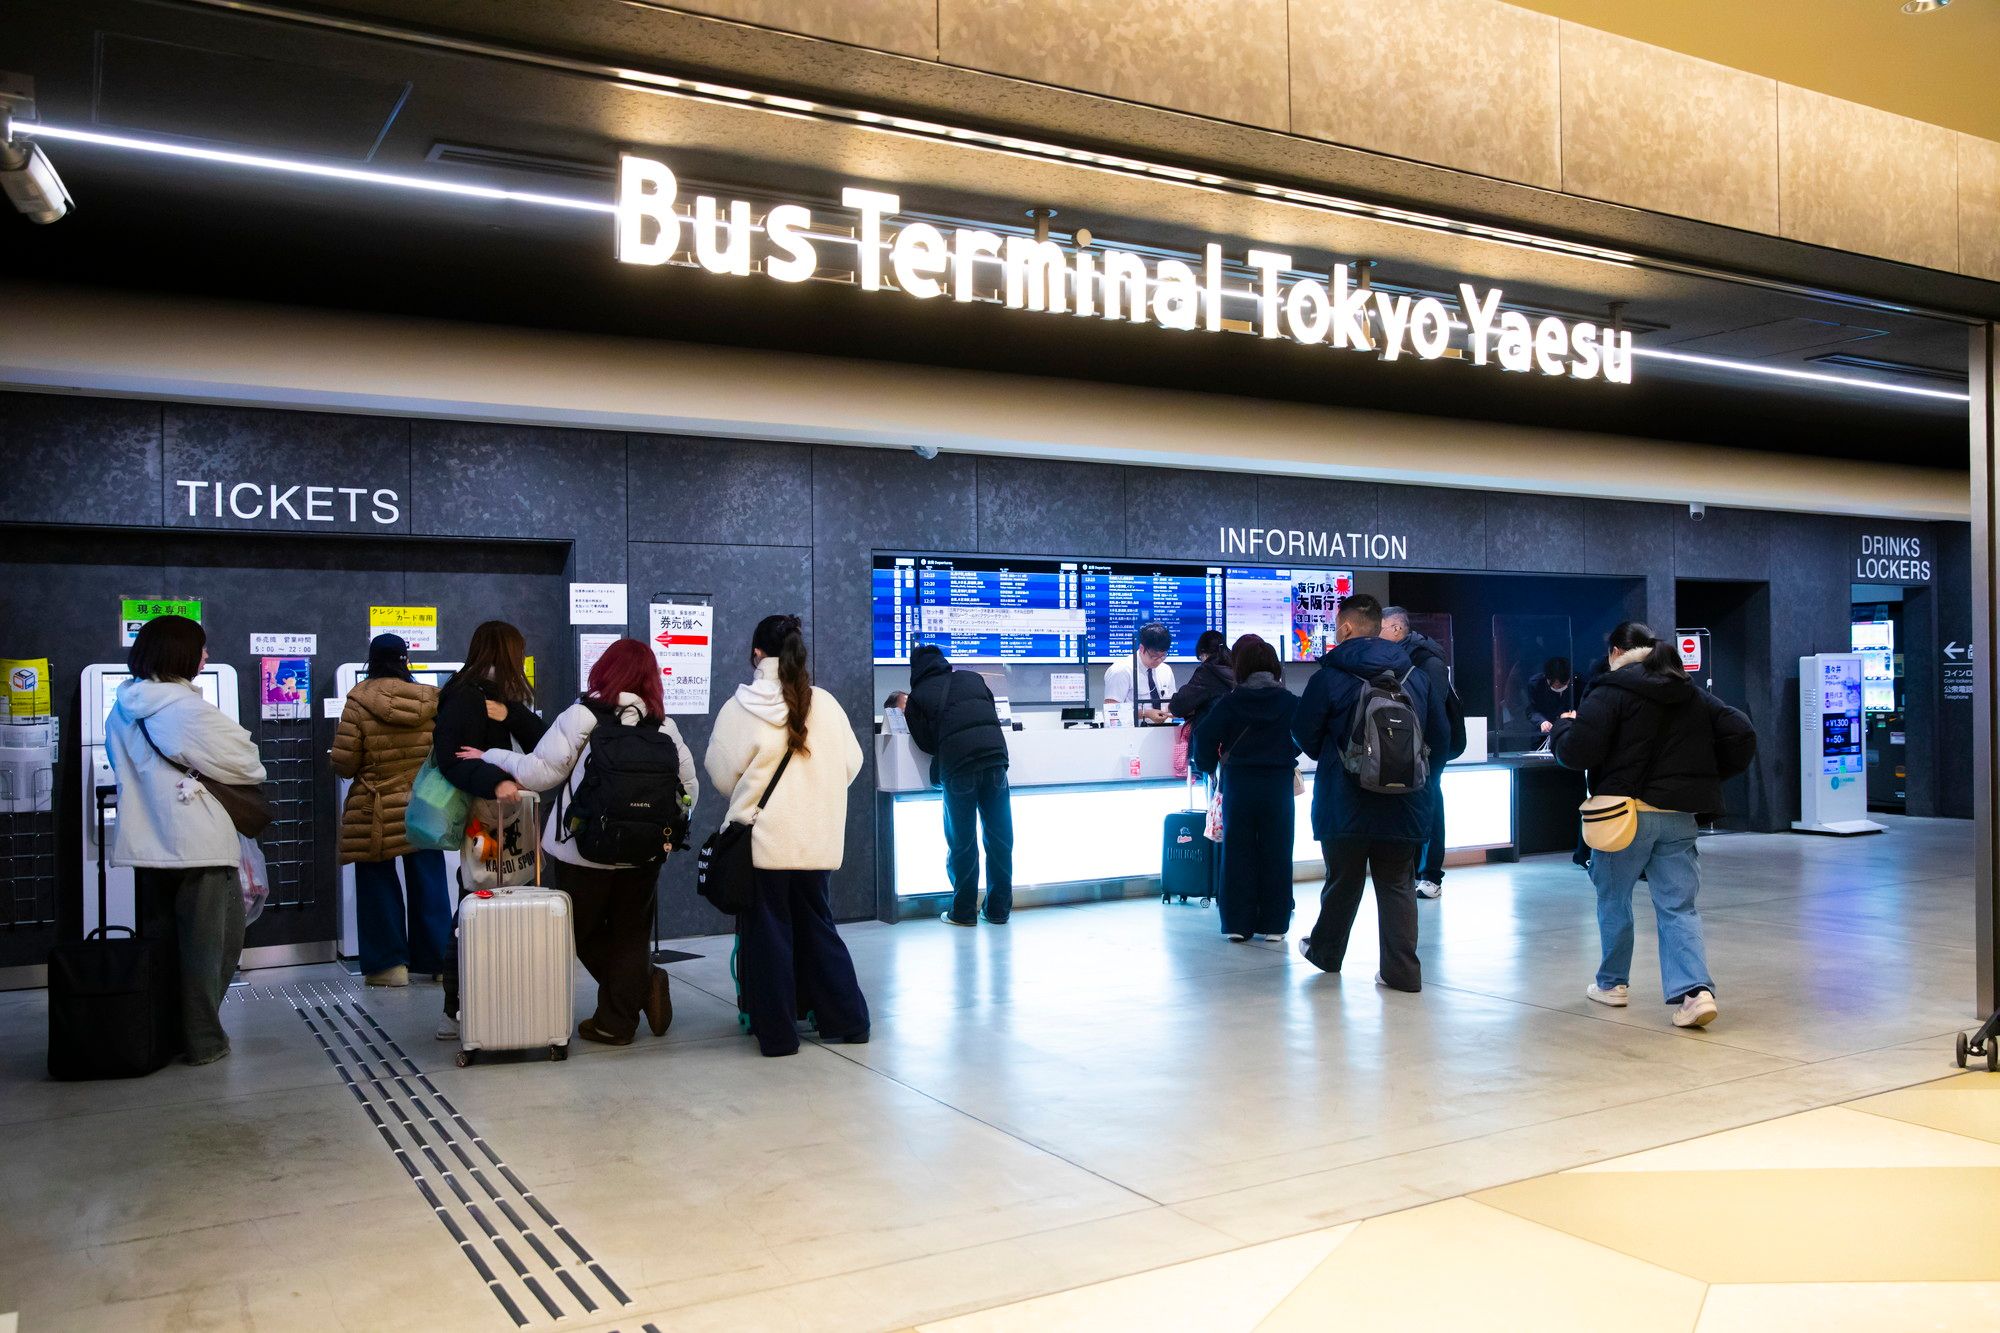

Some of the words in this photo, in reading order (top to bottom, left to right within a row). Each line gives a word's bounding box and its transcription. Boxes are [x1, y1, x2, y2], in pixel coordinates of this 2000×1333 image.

[618, 154, 818, 283] Bus
[842, 187, 1222, 333] Terminal
[1247, 249, 1451, 361] Tokyo
[1458, 282, 1633, 385] Yaesu
[176, 480, 400, 524] TICKETS
[1220, 527, 1408, 560] INFORMATION
[1861, 535, 1921, 557] DRINKS
[1857, 558, 1931, 580] LOCKERS
[1298, 582, 1334, 594] 夜行バス
[137, 604, 187, 614] 現金専用
[660, 616, 703, 629] 券売機へ
[485, 860, 516, 874] KAGOL
[518, 850, 535, 870] SPOR
